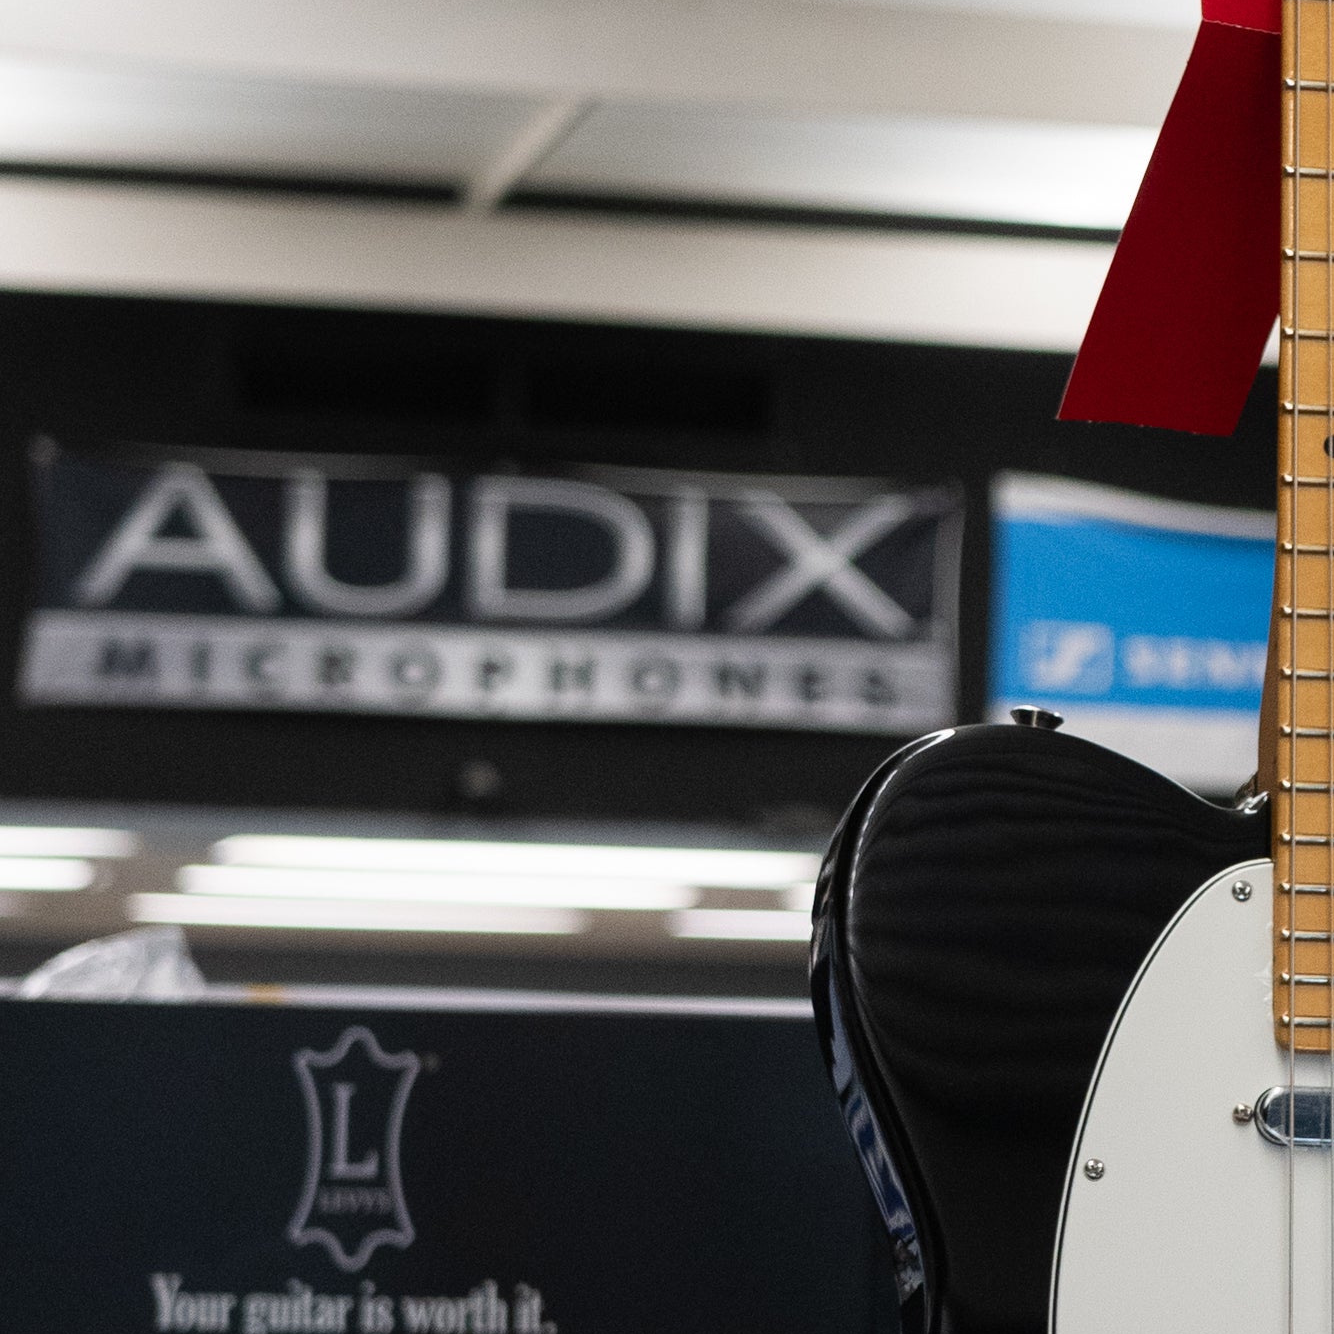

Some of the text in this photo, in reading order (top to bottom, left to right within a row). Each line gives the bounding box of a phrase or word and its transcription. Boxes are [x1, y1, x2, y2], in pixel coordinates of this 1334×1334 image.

[75, 461, 922, 639] AUDIX
[97, 635, 898, 707] MICROPHONES
[328, 1082, 379, 1180] L
[150, 1272, 237, 1333] Your
